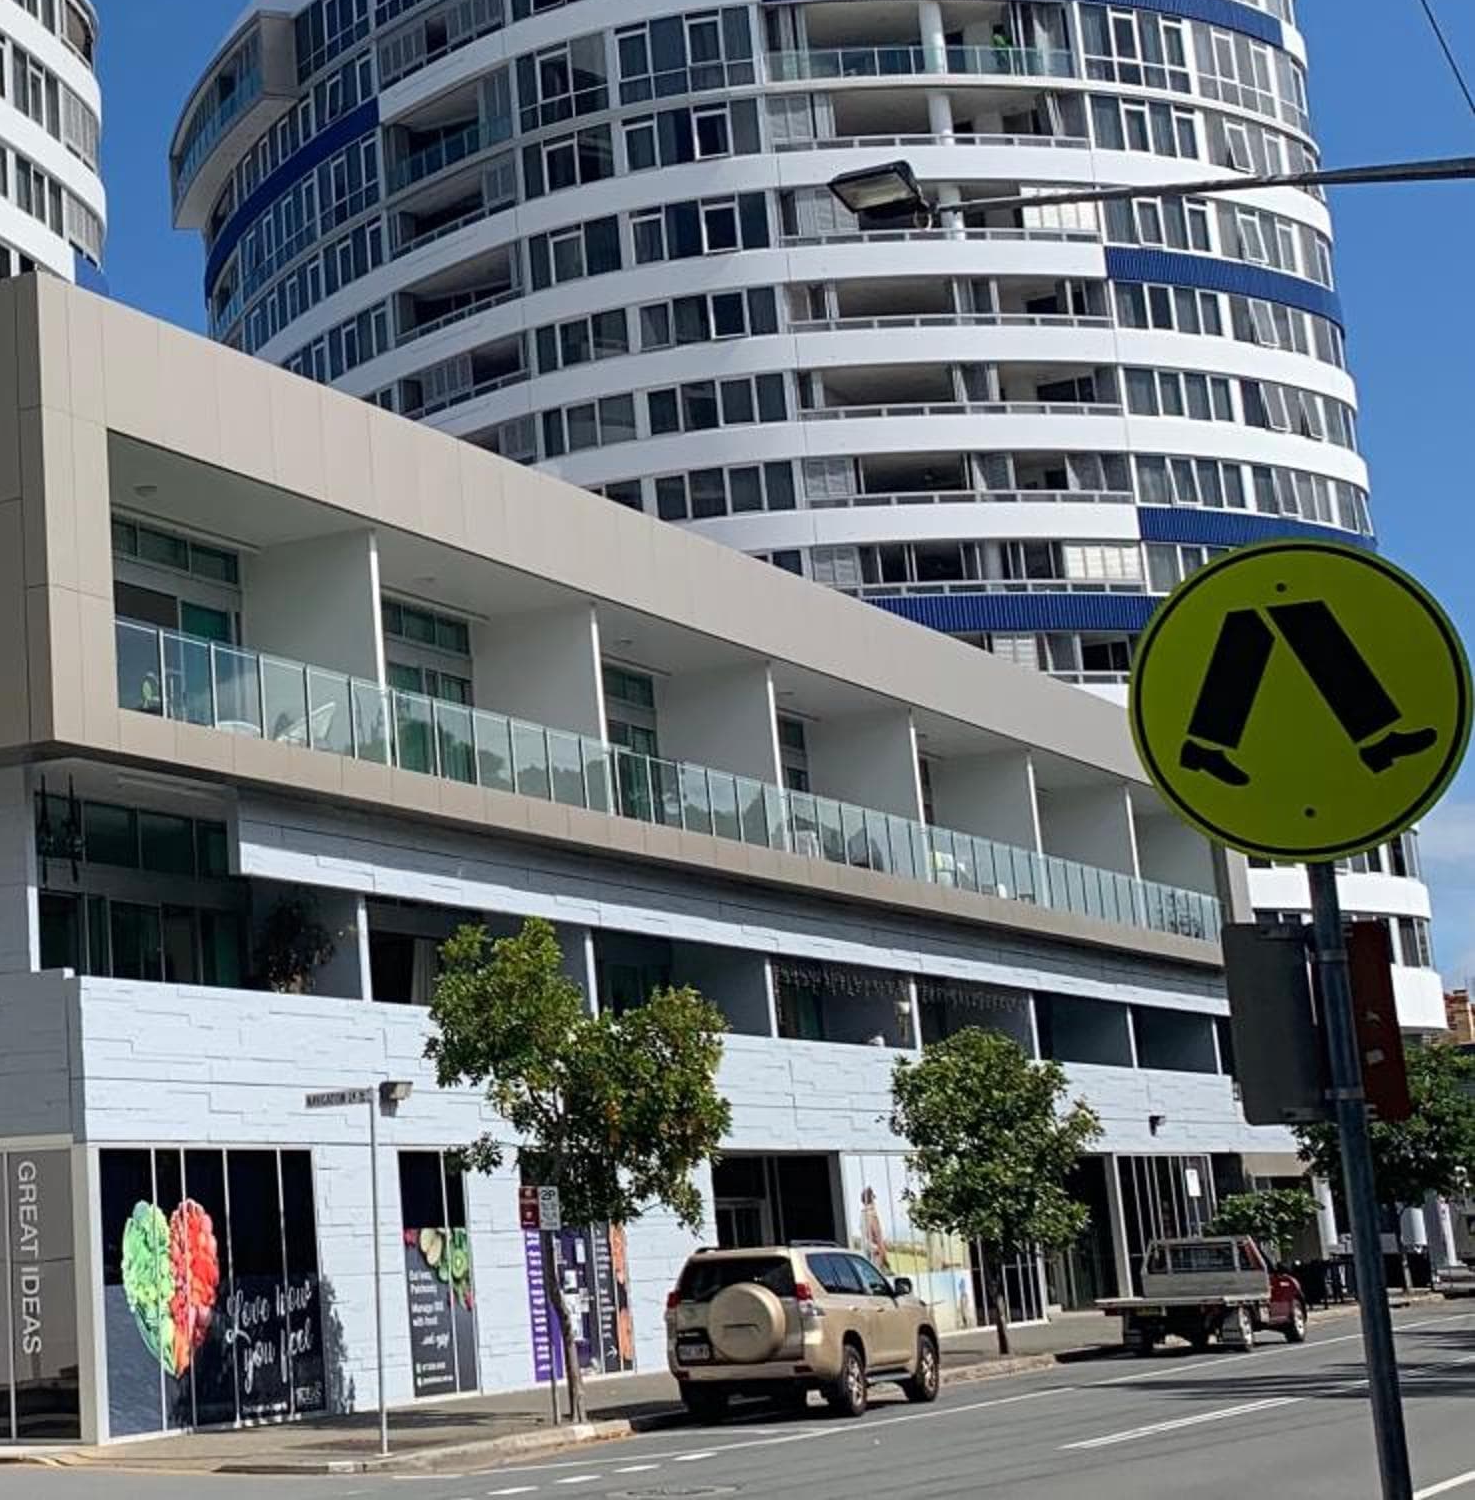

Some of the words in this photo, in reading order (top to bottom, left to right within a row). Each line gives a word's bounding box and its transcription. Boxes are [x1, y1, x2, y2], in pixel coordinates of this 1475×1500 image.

[18, 1161, 39, 1260] GREAT
[21, 1267, 42, 1354] IDEAS
[226, 1289, 271, 1343] Love
[244, 1341, 276, 1395] you
[280, 1316, 313, 1384] feel
